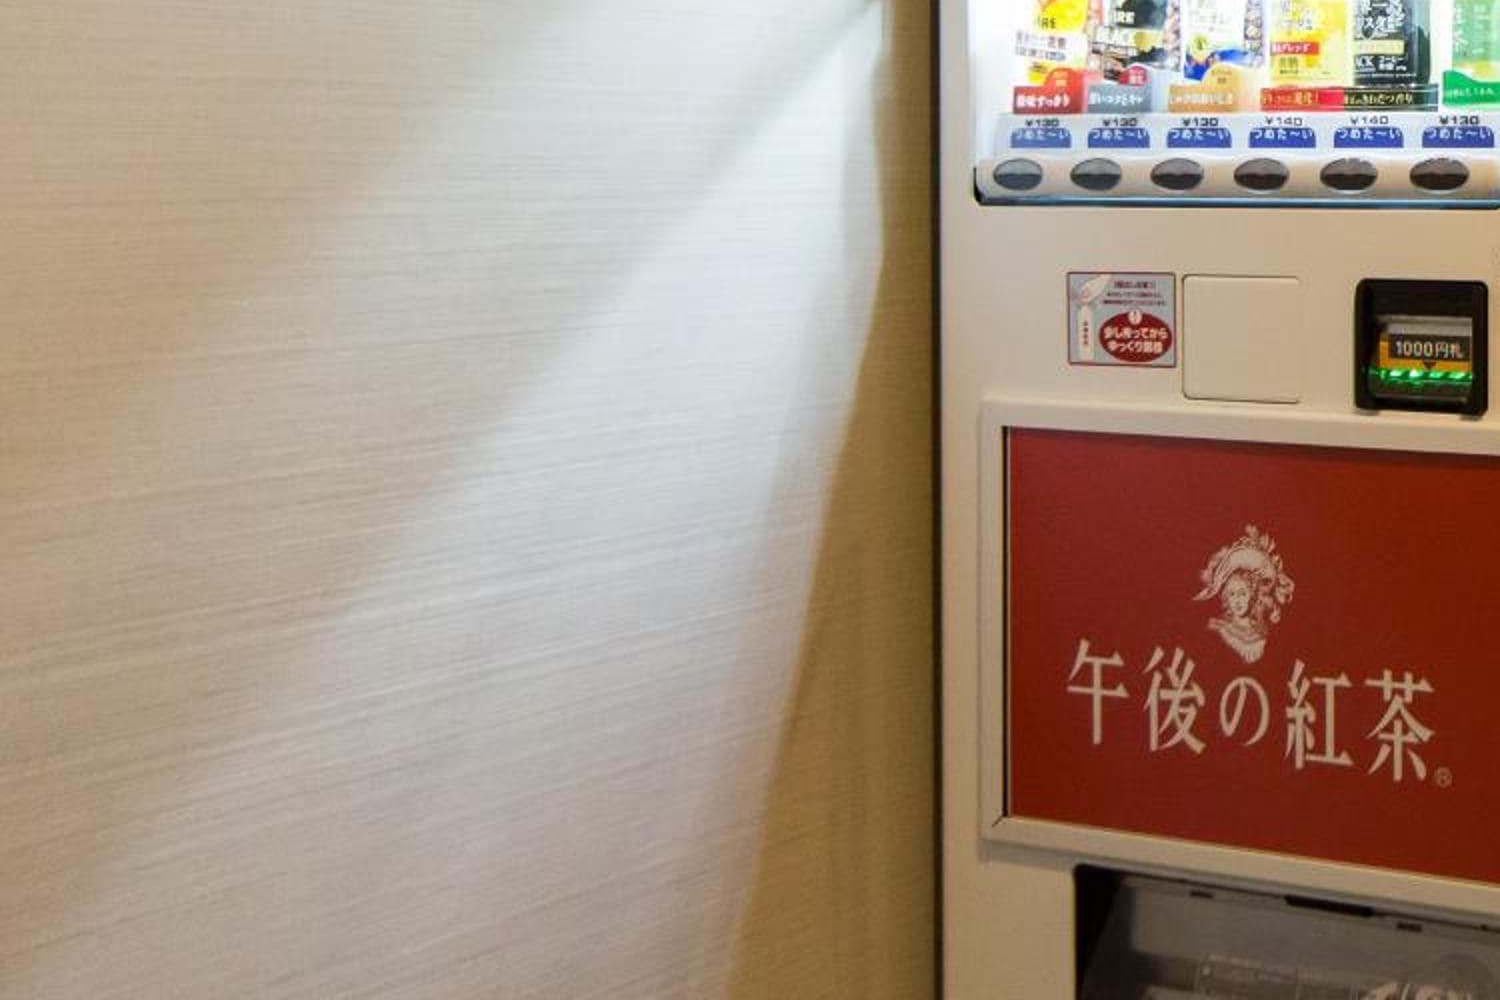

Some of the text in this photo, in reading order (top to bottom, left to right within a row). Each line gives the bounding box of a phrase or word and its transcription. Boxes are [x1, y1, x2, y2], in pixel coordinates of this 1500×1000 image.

[1025, 117, 1060, 127] ¥130
[1102, 117, 1138, 127] ¥130
[1182, 116, 1219, 127] ¥130
[1265, 116, 1303, 126] ¥140
[1350, 115, 1389, 125] ¥140
[1438, 115, 1480, 125] ¥130
[1392, 341, 1465, 359] 1000円札
[1067, 637, 1436, 782] 午後の紅茶
